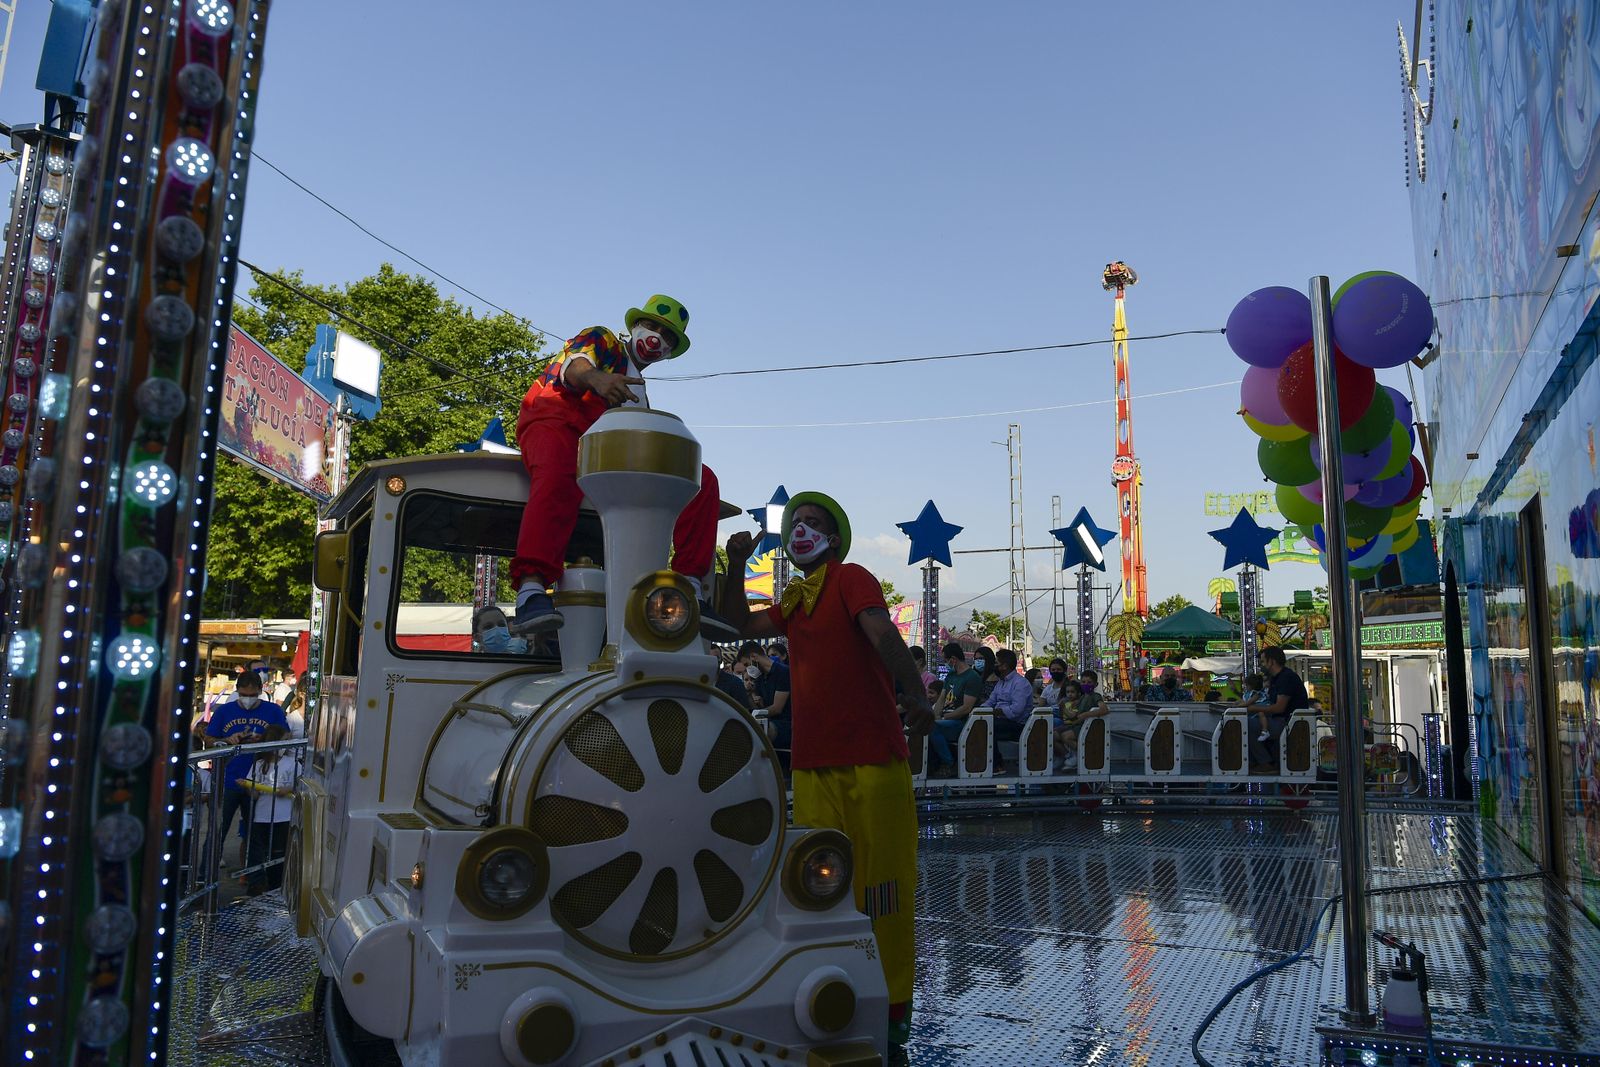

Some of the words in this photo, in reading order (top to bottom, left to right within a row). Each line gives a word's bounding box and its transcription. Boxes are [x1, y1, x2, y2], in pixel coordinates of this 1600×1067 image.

[227, 337, 290, 403] TACIÓN
[303, 396, 323, 427] DE
[225, 374, 248, 412] TA
[259, 398, 307, 448] LUCÍA
[1361, 625, 1443, 643] URGUESER
[223, 718, 247, 733] UNITED
[249, 718, 270, 729] STATE
